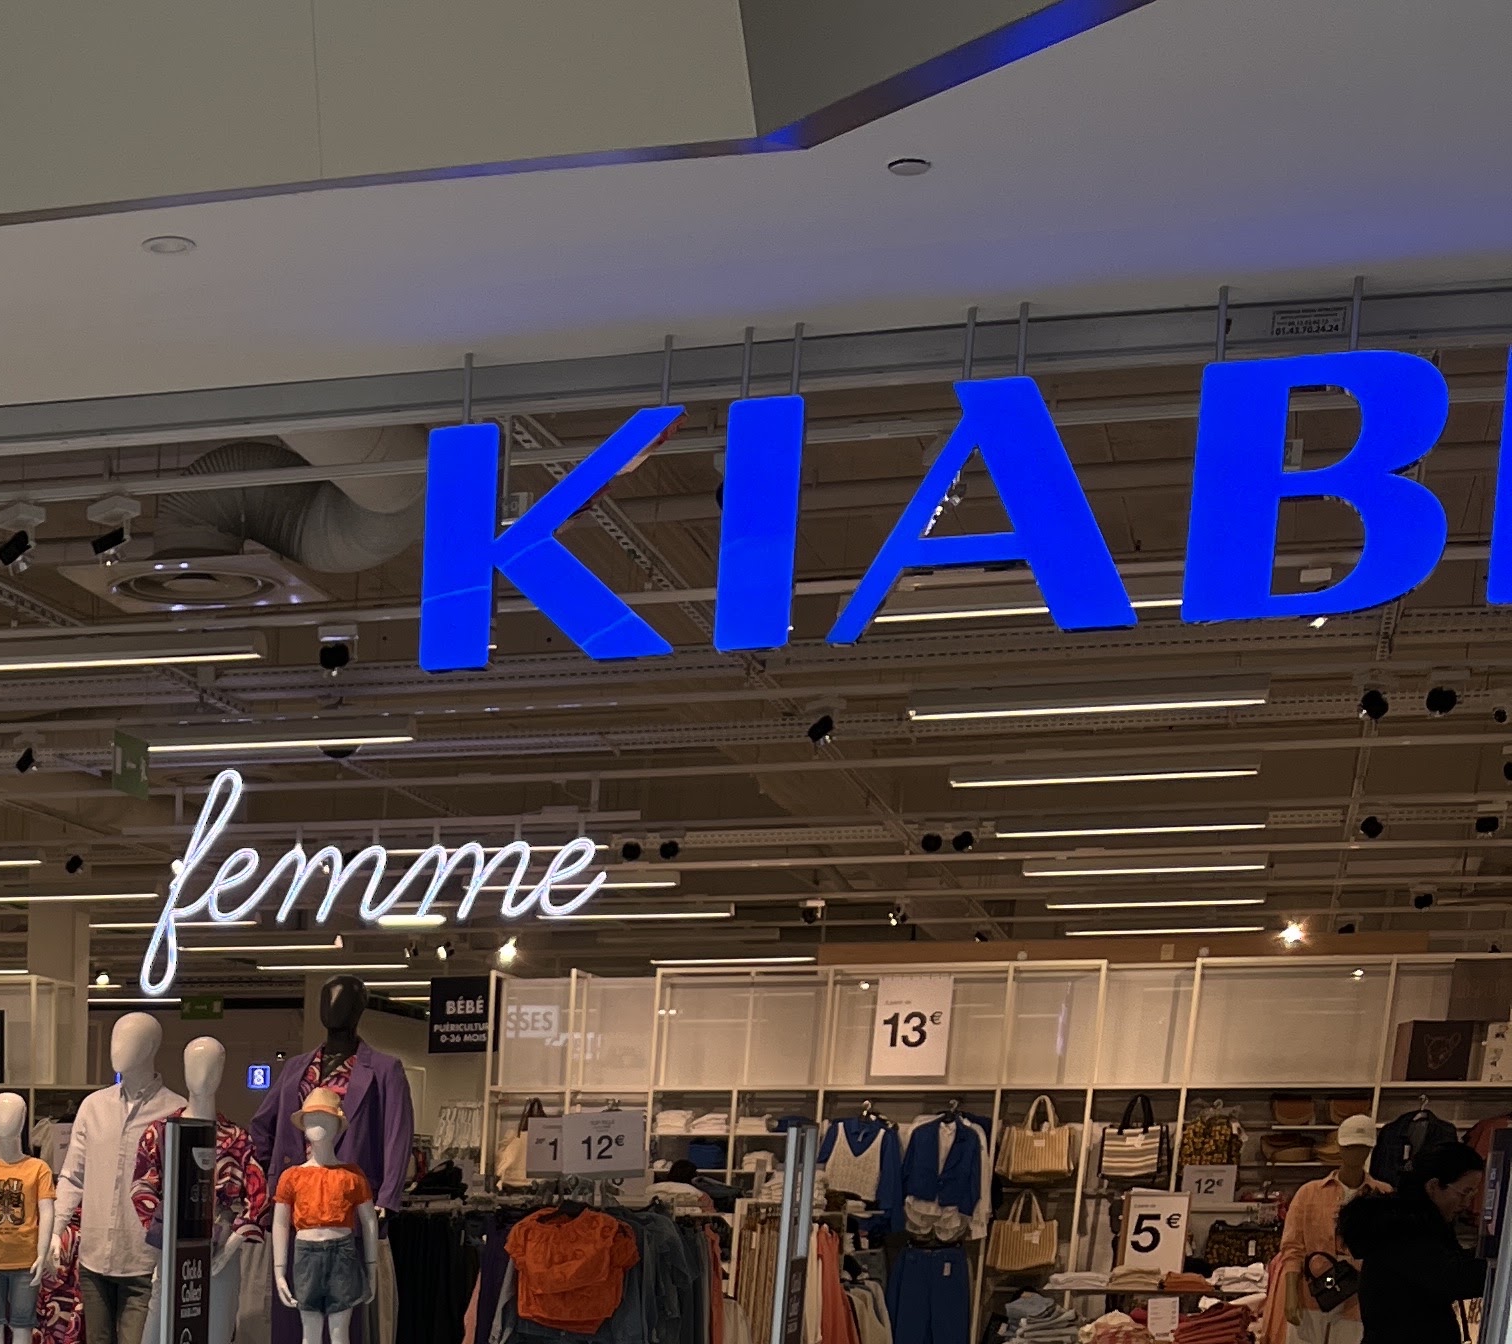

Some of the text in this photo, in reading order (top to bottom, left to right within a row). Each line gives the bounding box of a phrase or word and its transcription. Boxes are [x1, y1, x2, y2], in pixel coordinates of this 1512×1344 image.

[139, 768, 607, 996] femme
[445, 995, 485, 1015] BÉBÉ
[440, 1033, 487, 1043] 0-36 MOIS
[883, 1011, 943, 1048] 13€
[581, 1134, 625, 1160] 12€
[1195, 1178, 1224, 1194] 12€
[1130, 1213, 1182, 1253] 5€
